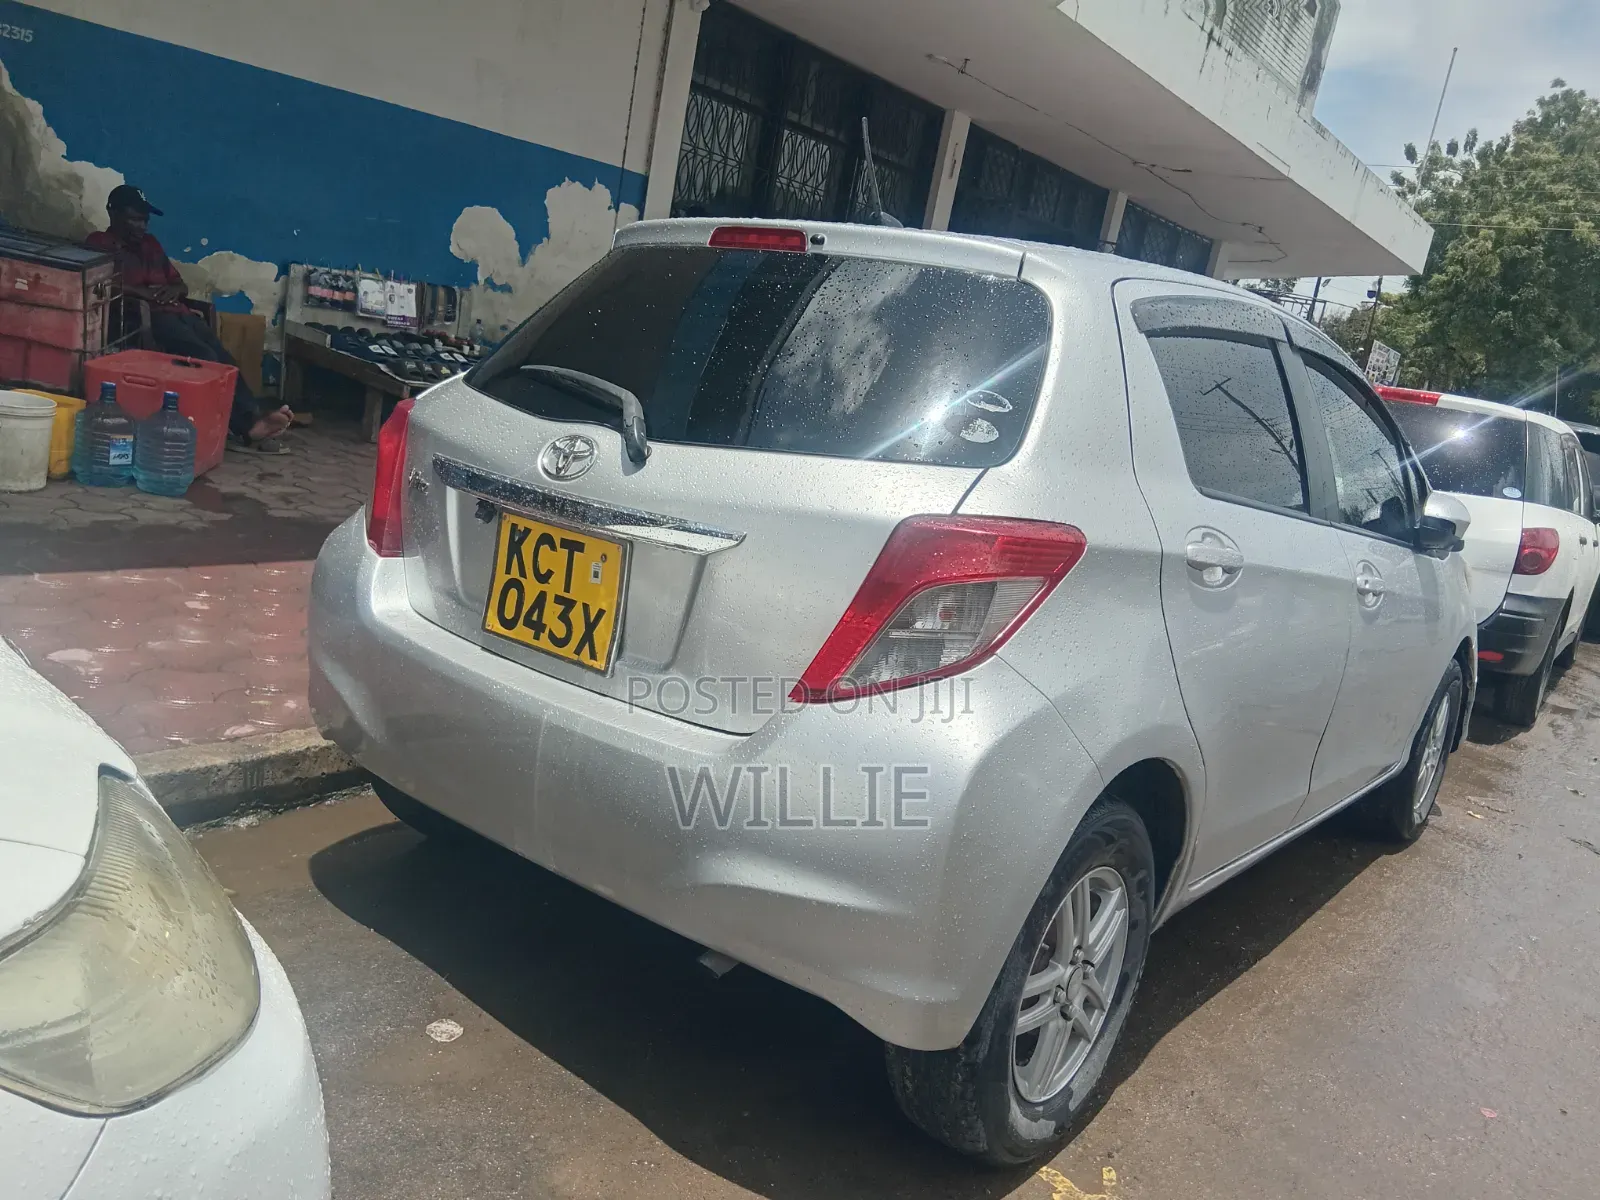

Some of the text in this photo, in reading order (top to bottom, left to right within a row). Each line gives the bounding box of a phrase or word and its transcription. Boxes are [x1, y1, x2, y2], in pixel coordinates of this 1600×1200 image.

[0, 23, 34, 43] 2315
[505, 523, 586, 593] KCT
[496, 578, 607, 662] 043X
